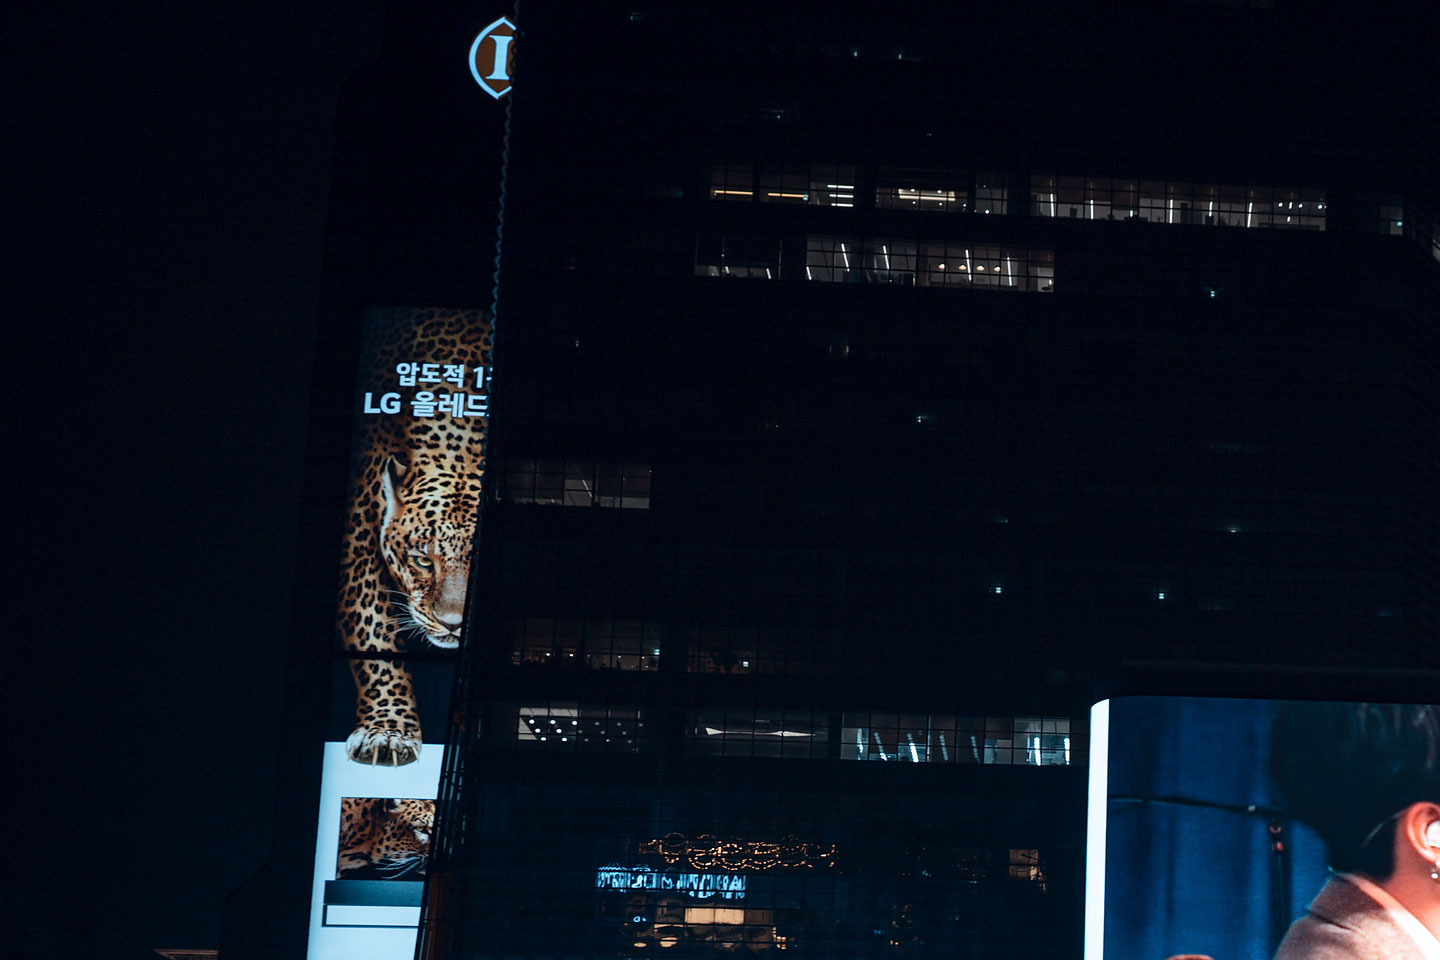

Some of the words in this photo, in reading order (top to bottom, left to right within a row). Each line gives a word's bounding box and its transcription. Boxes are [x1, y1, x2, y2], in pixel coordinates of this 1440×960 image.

[396, 362, 465, 388] 압도적
[473, 366, 491, 388] 1
[364, 392, 402, 414] LG
[411, 391, 489, 418] 올레드
